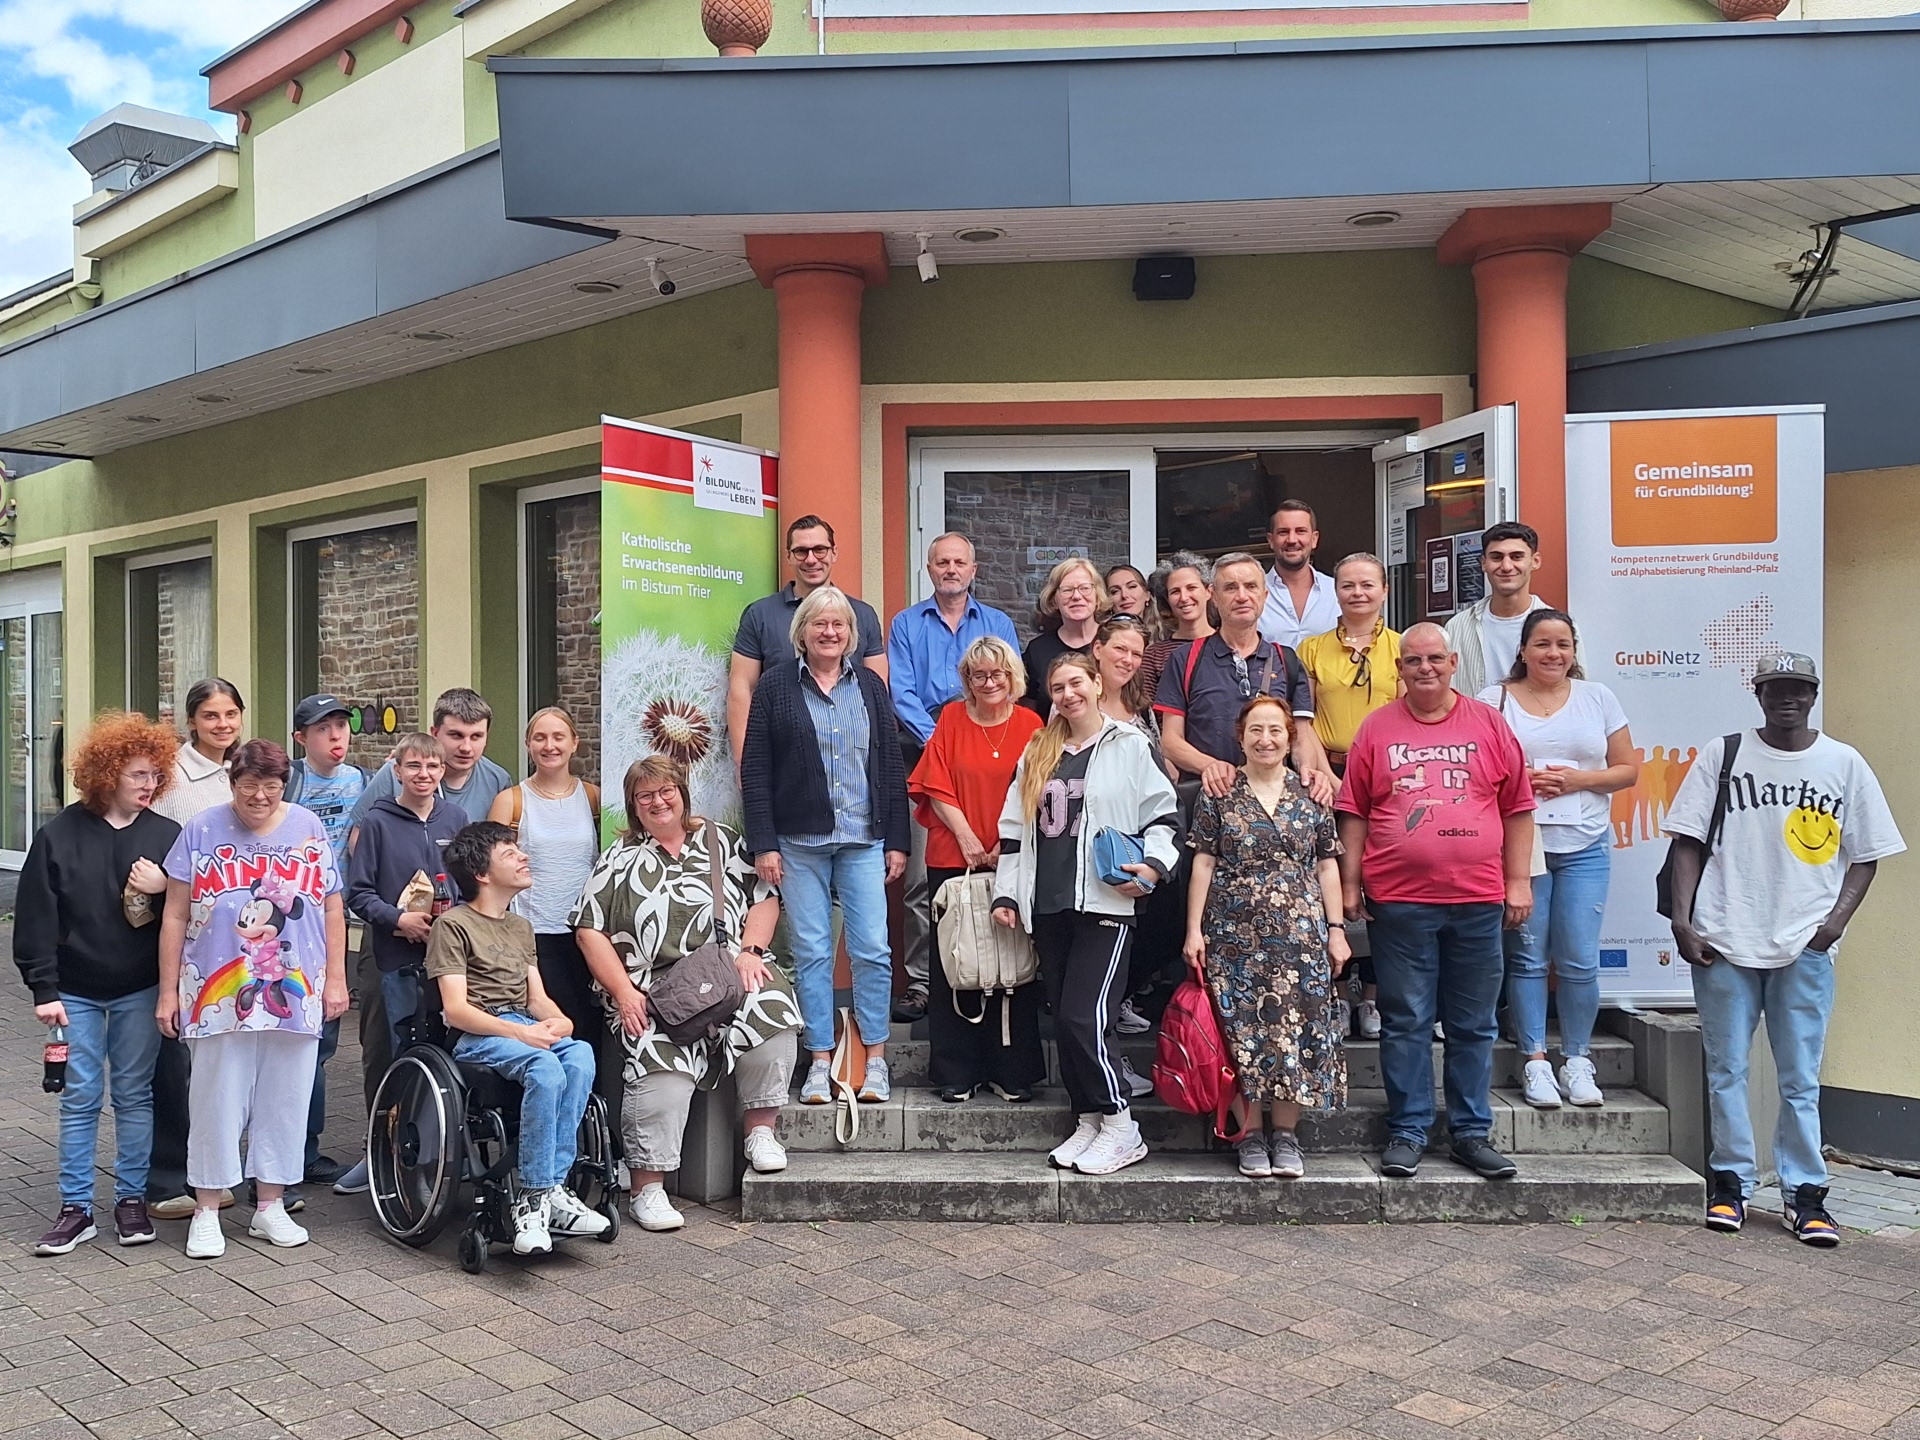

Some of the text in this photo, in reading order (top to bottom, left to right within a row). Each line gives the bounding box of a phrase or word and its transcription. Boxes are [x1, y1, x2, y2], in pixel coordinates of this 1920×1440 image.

[1634, 462, 1753, 481] Gemeinsam
[705, 476, 742, 491] BILDUNG
[1634, 483, 1754, 498] für Grundbildung!
[730, 493, 756, 505] LEBEN
[621, 531, 692, 554] Katholische
[1610, 552, 1779, 565] Kompetenznetzwerk Grundbildung
[621, 554, 743, 584] Erwachsenenbildung
[1610, 565, 1779, 578] und Alphabetisierung Rheinland-Pfalz
[622, 576, 711, 599] im Bistum Trier
[1615, 650, 1701, 666] GrubiNetz
[1441, 768, 1471, 789] IT
[1437, 828, 1479, 837] adidas
[1599, 937, 1627, 945] rubiNetz
